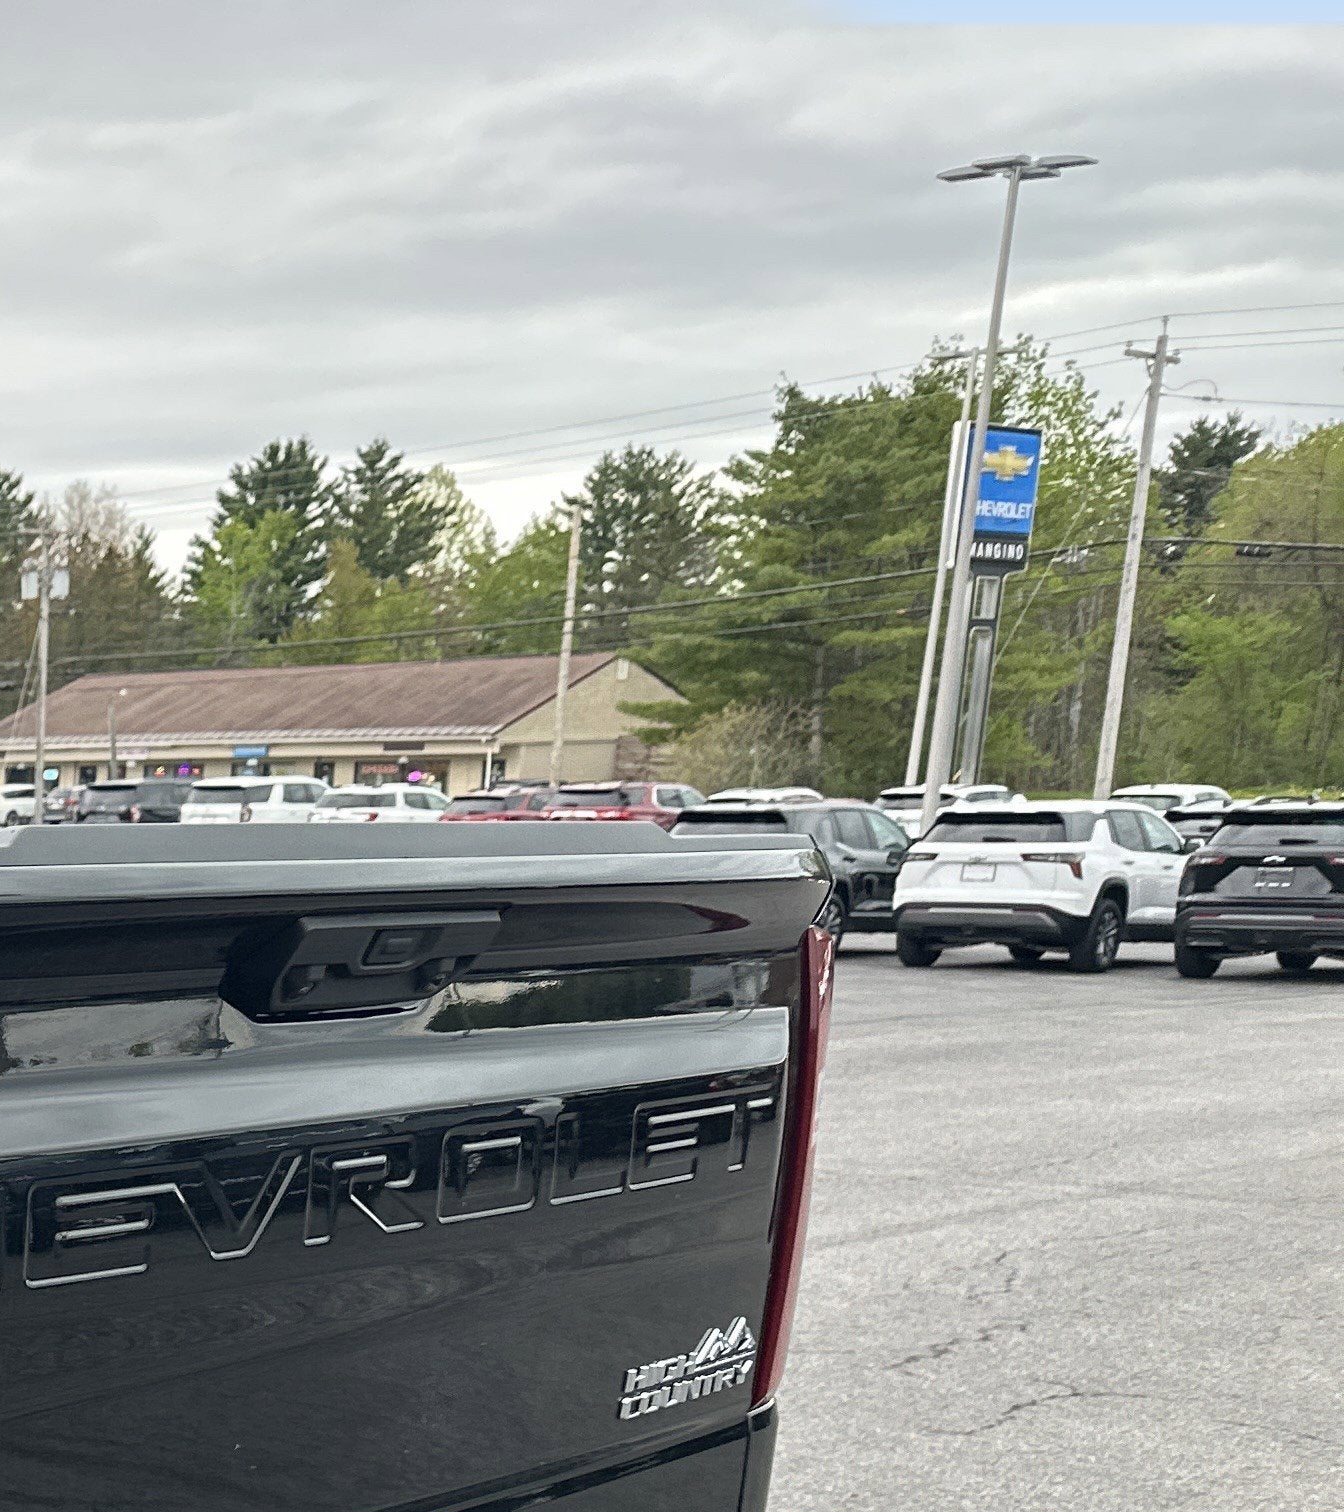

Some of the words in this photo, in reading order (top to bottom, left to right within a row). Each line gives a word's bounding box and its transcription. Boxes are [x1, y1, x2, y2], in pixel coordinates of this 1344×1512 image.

[976, 499, 1032, 519] HEVROLET
[619, 1359, 754, 1420] COUNTRY
[623, 1352, 699, 1394] HIGH
